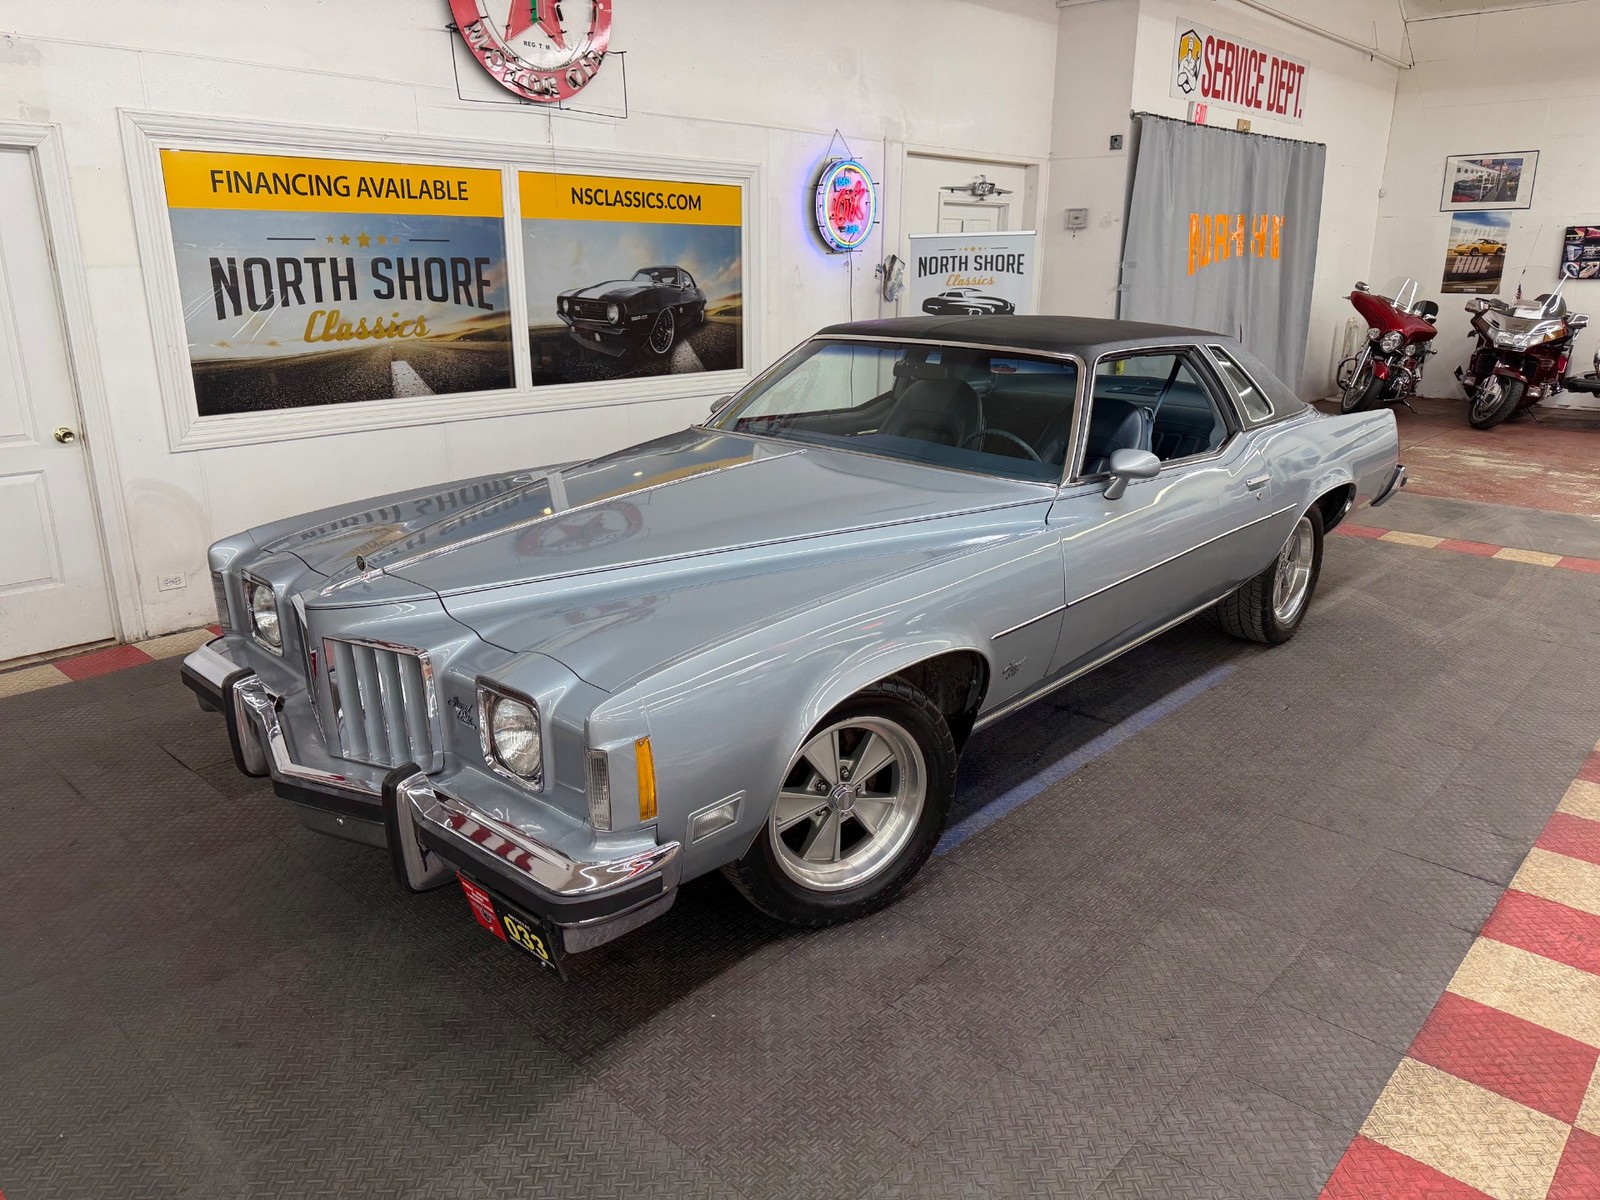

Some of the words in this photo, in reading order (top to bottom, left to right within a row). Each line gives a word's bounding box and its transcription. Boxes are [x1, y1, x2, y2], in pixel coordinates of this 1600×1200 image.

[1201, 35, 1267, 109] SERVICE
[1266, 56, 1305, 119] DEPT.
[210, 169, 350, 197] FINANCING
[357, 176, 469, 201] AVAILABLE
[571, 187, 702, 211] NSCLASSICS.COM
[918, 255, 968, 278] NORTH
[974, 253, 1025, 275] SHORE
[946, 274, 995, 287] Classics
[1452, 256, 1492, 273] RIDE
[209, 257, 357, 321] NORTH
[371, 256, 494, 311] SHORE
[303, 309, 430, 344] Classics
[504, 916, 549, 960] 033
